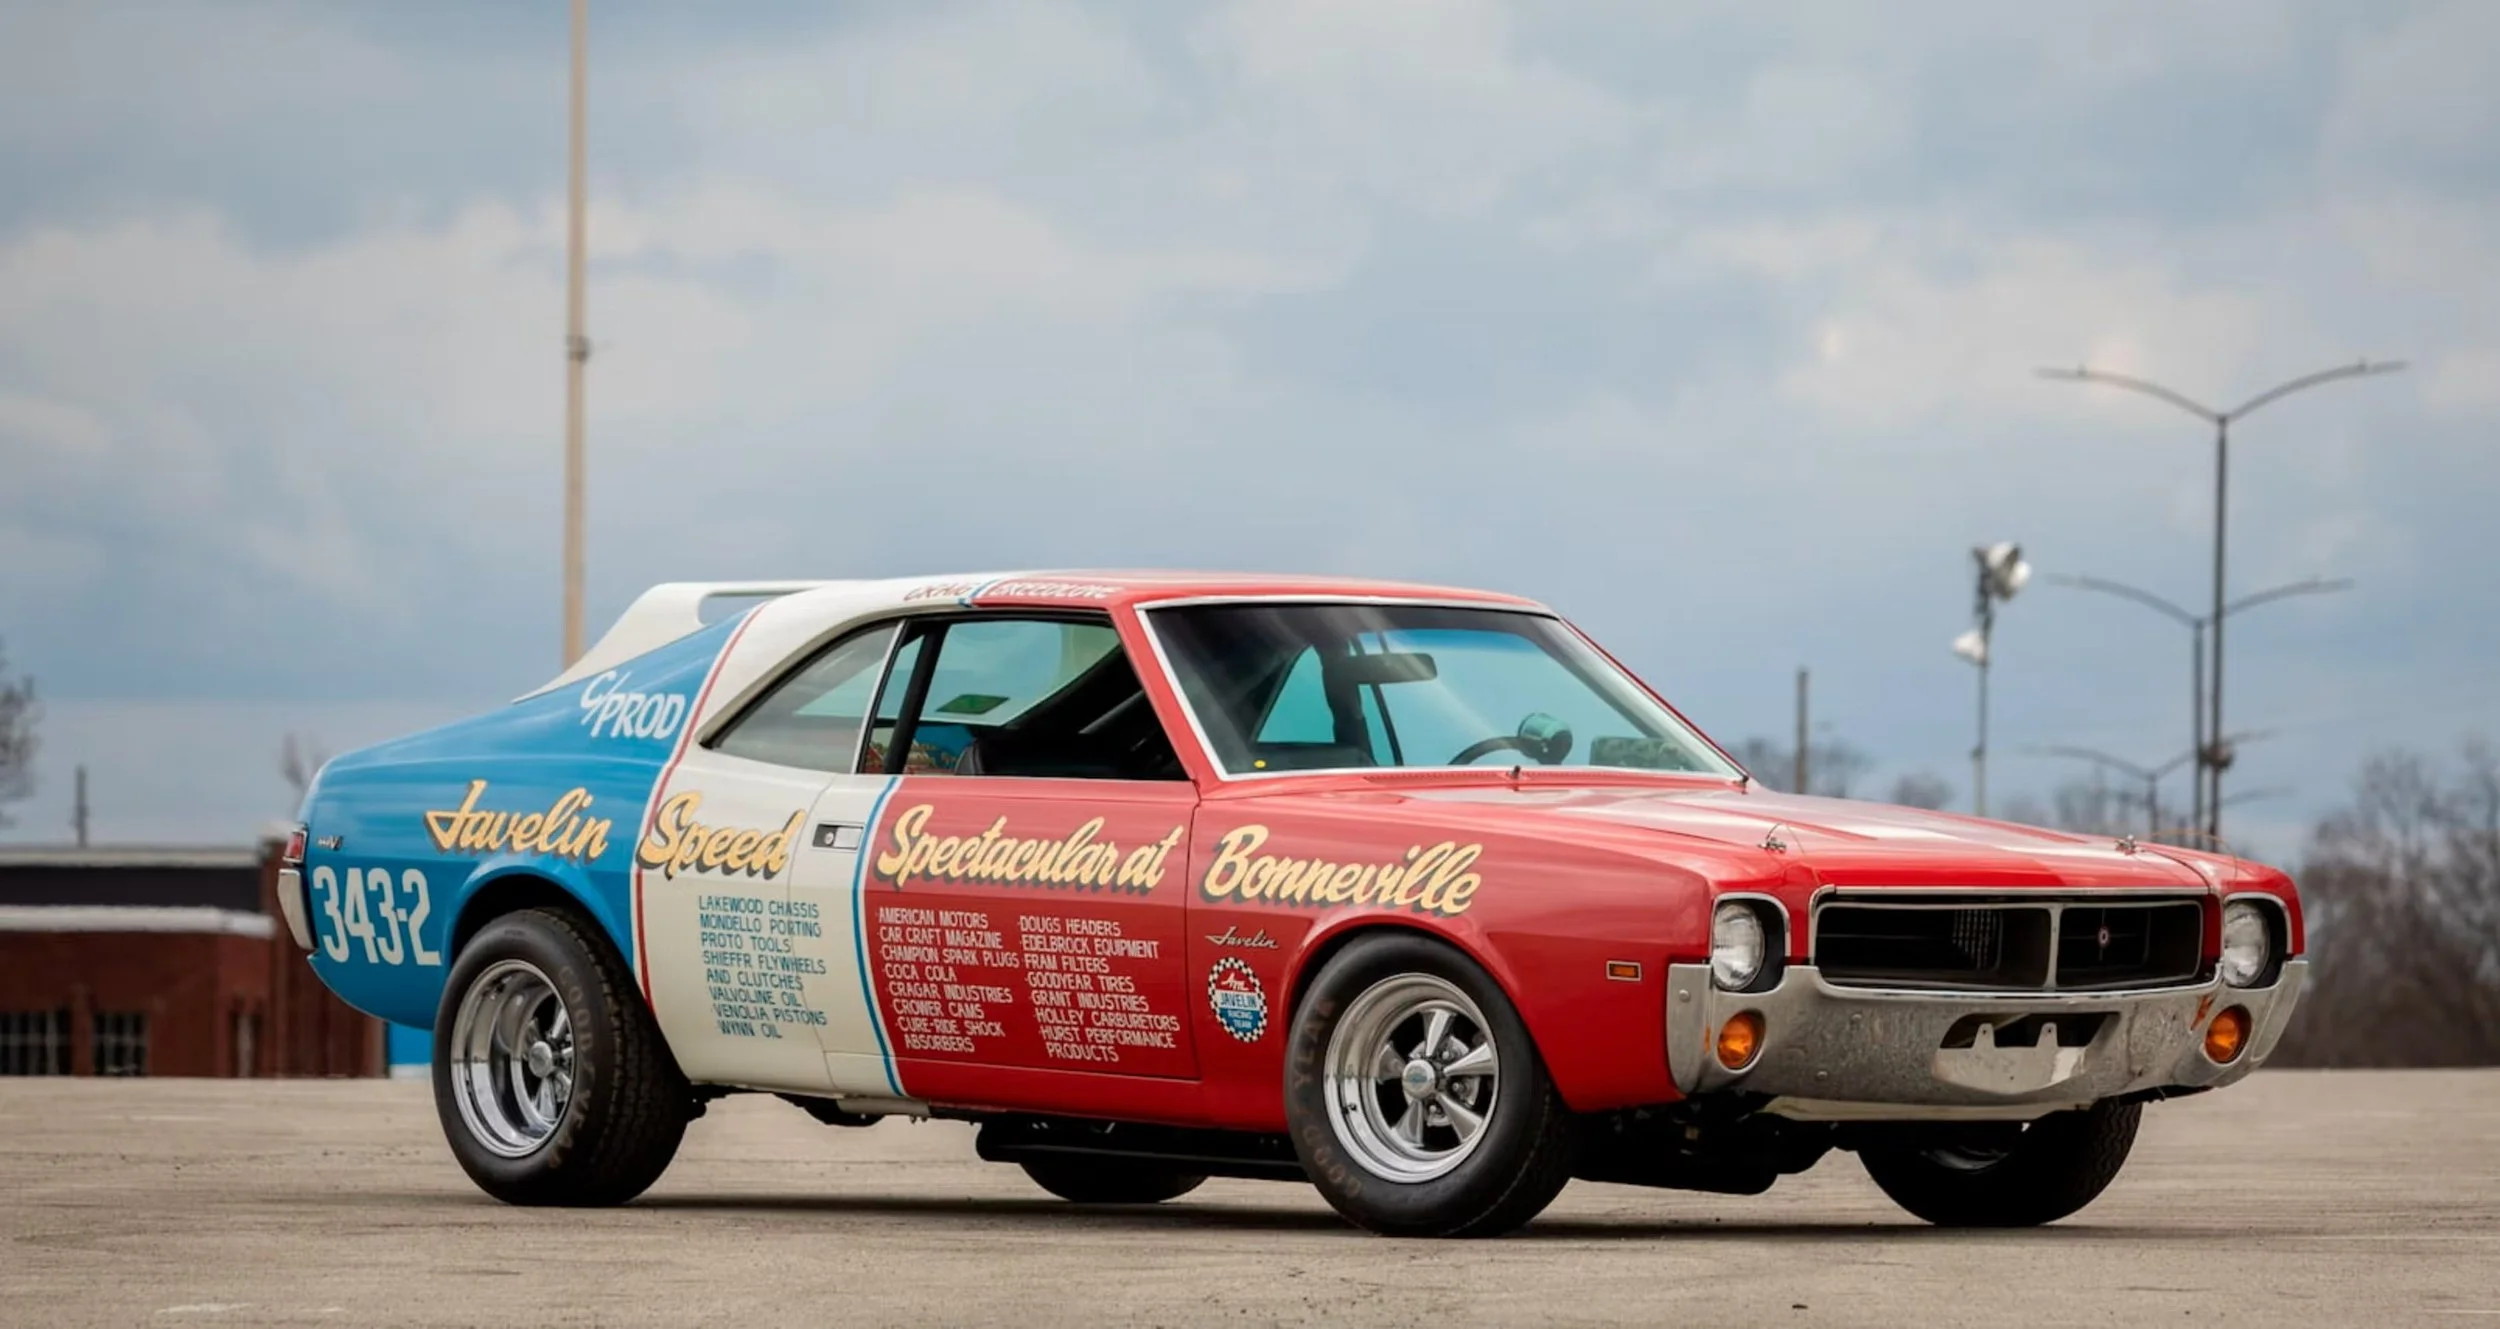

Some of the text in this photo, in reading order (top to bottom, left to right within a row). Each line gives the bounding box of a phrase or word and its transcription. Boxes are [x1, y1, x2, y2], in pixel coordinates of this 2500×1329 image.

[580, 670, 686, 739] C/PROD
[424, 779, 612, 864] Javelin
[635, 790, 807, 880] Speed
[875, 804, 1184, 894] Spectacular at
[1202, 824, 1483, 916] Bonneville
[313, 866, 441, 965] 343-2
[699, 895, 820, 918] LAKEWOOD CHASSIS
[699, 914, 822, 938] MONDELLO PORTING
[879, 907, 988, 929] AMERICAN MOTORS
[1019, 915, 1121, 937] DOUGS HEADERS
[701, 932, 791, 953] PROTO TOOLS
[880, 926, 1003, 949] CAR CRAFT MAGAZINE
[1021, 934, 1159, 958] EDELBROCK EQUIPMENT
[1204, 926, 1280, 949] Javelin
[758, 955, 827, 975] FLYWHEELS
[881, 944, 1020, 968] CHAMPION SPARK PLUGS
[1024, 953, 1110, 974] FRAM FILTERS
[706, 968, 803, 991] AND CLUTCHES
[884, 963, 957, 982] COCA COLA
[1027, 971, 1135, 993] GOODYEAR TIRES
[709, 986, 802, 1007] VALVOLINE OIL
[889, 981, 1013, 1003] CRAGAR INDUSTRIES
[1031, 990, 1150, 1012] GRANT INDUSTRIES
[1220, 992, 1257, 1008] JAVELIN
[713, 1003, 827, 1026] VENOLIA PISTONS
[892, 999, 984, 1019] CROWER CAMS
[1035, 1007, 1180, 1031] HOLLEY CARBURETORS
[718, 1020, 783, 1039] WYNN OIL
[897, 1016, 1005, 1037] CURE-RIDE SHOCK
[1040, 1025, 1176, 1048] HURST PERFORMANCE
[904, 1033, 975, 1052] ABSORBERS
[1046, 1042, 1120, 1062] PRODUCTS
